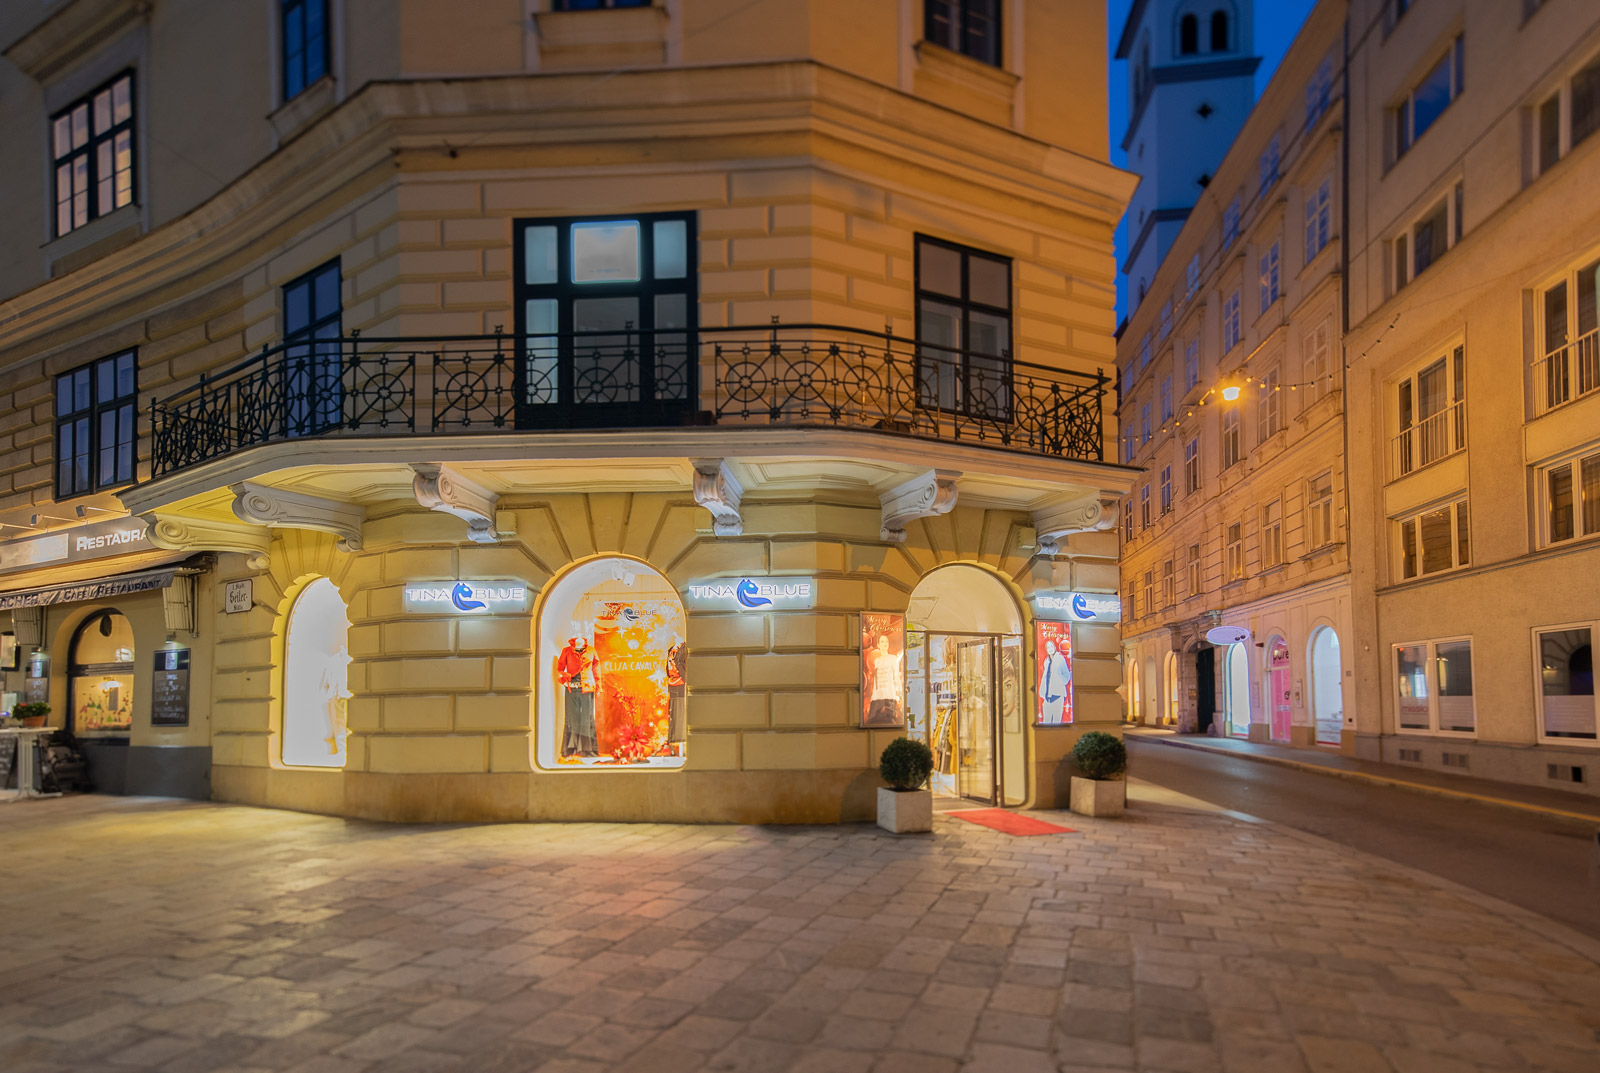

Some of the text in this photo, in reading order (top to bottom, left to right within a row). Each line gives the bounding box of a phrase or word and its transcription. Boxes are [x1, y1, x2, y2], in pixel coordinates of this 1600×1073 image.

[408, 588, 523, 600] TINA BLUE
[690, 584, 810, 597] TINA BLUE
[1038, 597, 1069, 608] TNA
[604, 661, 628, 671] ELISA
